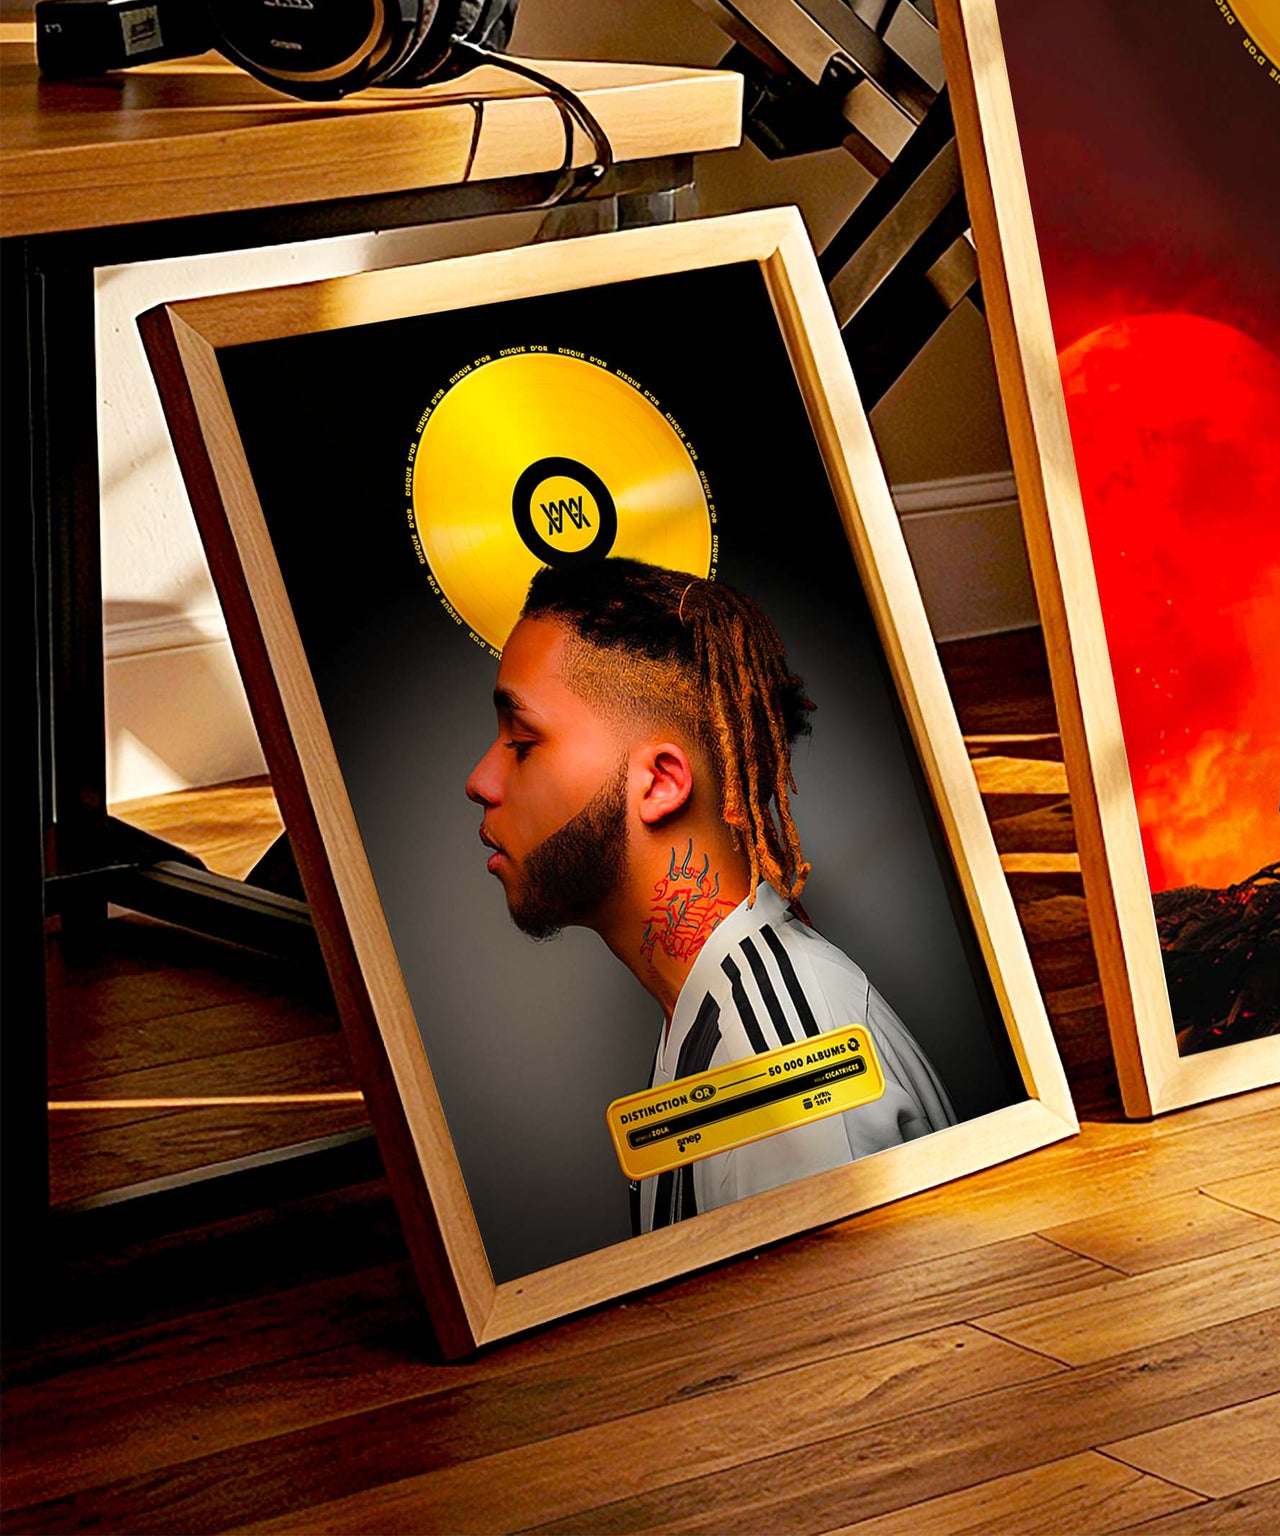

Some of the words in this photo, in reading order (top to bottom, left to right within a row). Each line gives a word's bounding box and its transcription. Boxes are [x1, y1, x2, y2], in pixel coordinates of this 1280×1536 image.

[1242, 38, 1267, 66] D'OR
[499, 345, 526, 357] DISQUE
[557, 347, 585, 359] DISQUE
[589, 356, 607, 368] D'OR
[449, 364, 473, 384] DISQUE
[474, 355, 492, 367] D'OR
[616, 369, 641, 390] DISQUE
[643, 389, 660, 407] D'OR
[415, 407, 433, 433] DISQUE
[431, 388, 445, 406] D'OR
[665, 412, 686, 439] DISQUE
[685, 441, 699, 461] D'OR
[407, 442, 417, 462] D'OR
[405, 466, 413, 497] DISQUE
[699, 470, 713, 499] DISQUE
[709, 504, 717, 524] D'OR
[406, 508, 415, 529] D'OR
[411, 534, 426, 565] DISQUE
[711, 534, 719, 564] DISQUE
[426, 574, 441, 595] D'OR
[440, 598, 463, 625] DISQUE
[468, 631, 486, 648] D'OR
[620, 1095, 688, 1124] DISTINCTION
[695, 1088, 711, 1099] OR
[768, 1065, 782, 1076] 50
[783, 1058, 804, 1071] 000
[806, 1044, 846, 1064] ALBUMS
[825, 1064, 859, 1080] CICATRICES
[813, 1091, 832, 1101] AVRIL
[815, 1097, 832, 1106] 2019
[652, 1127, 670, 1137] ZOLA
[676, 1132, 701, 1152] snep
